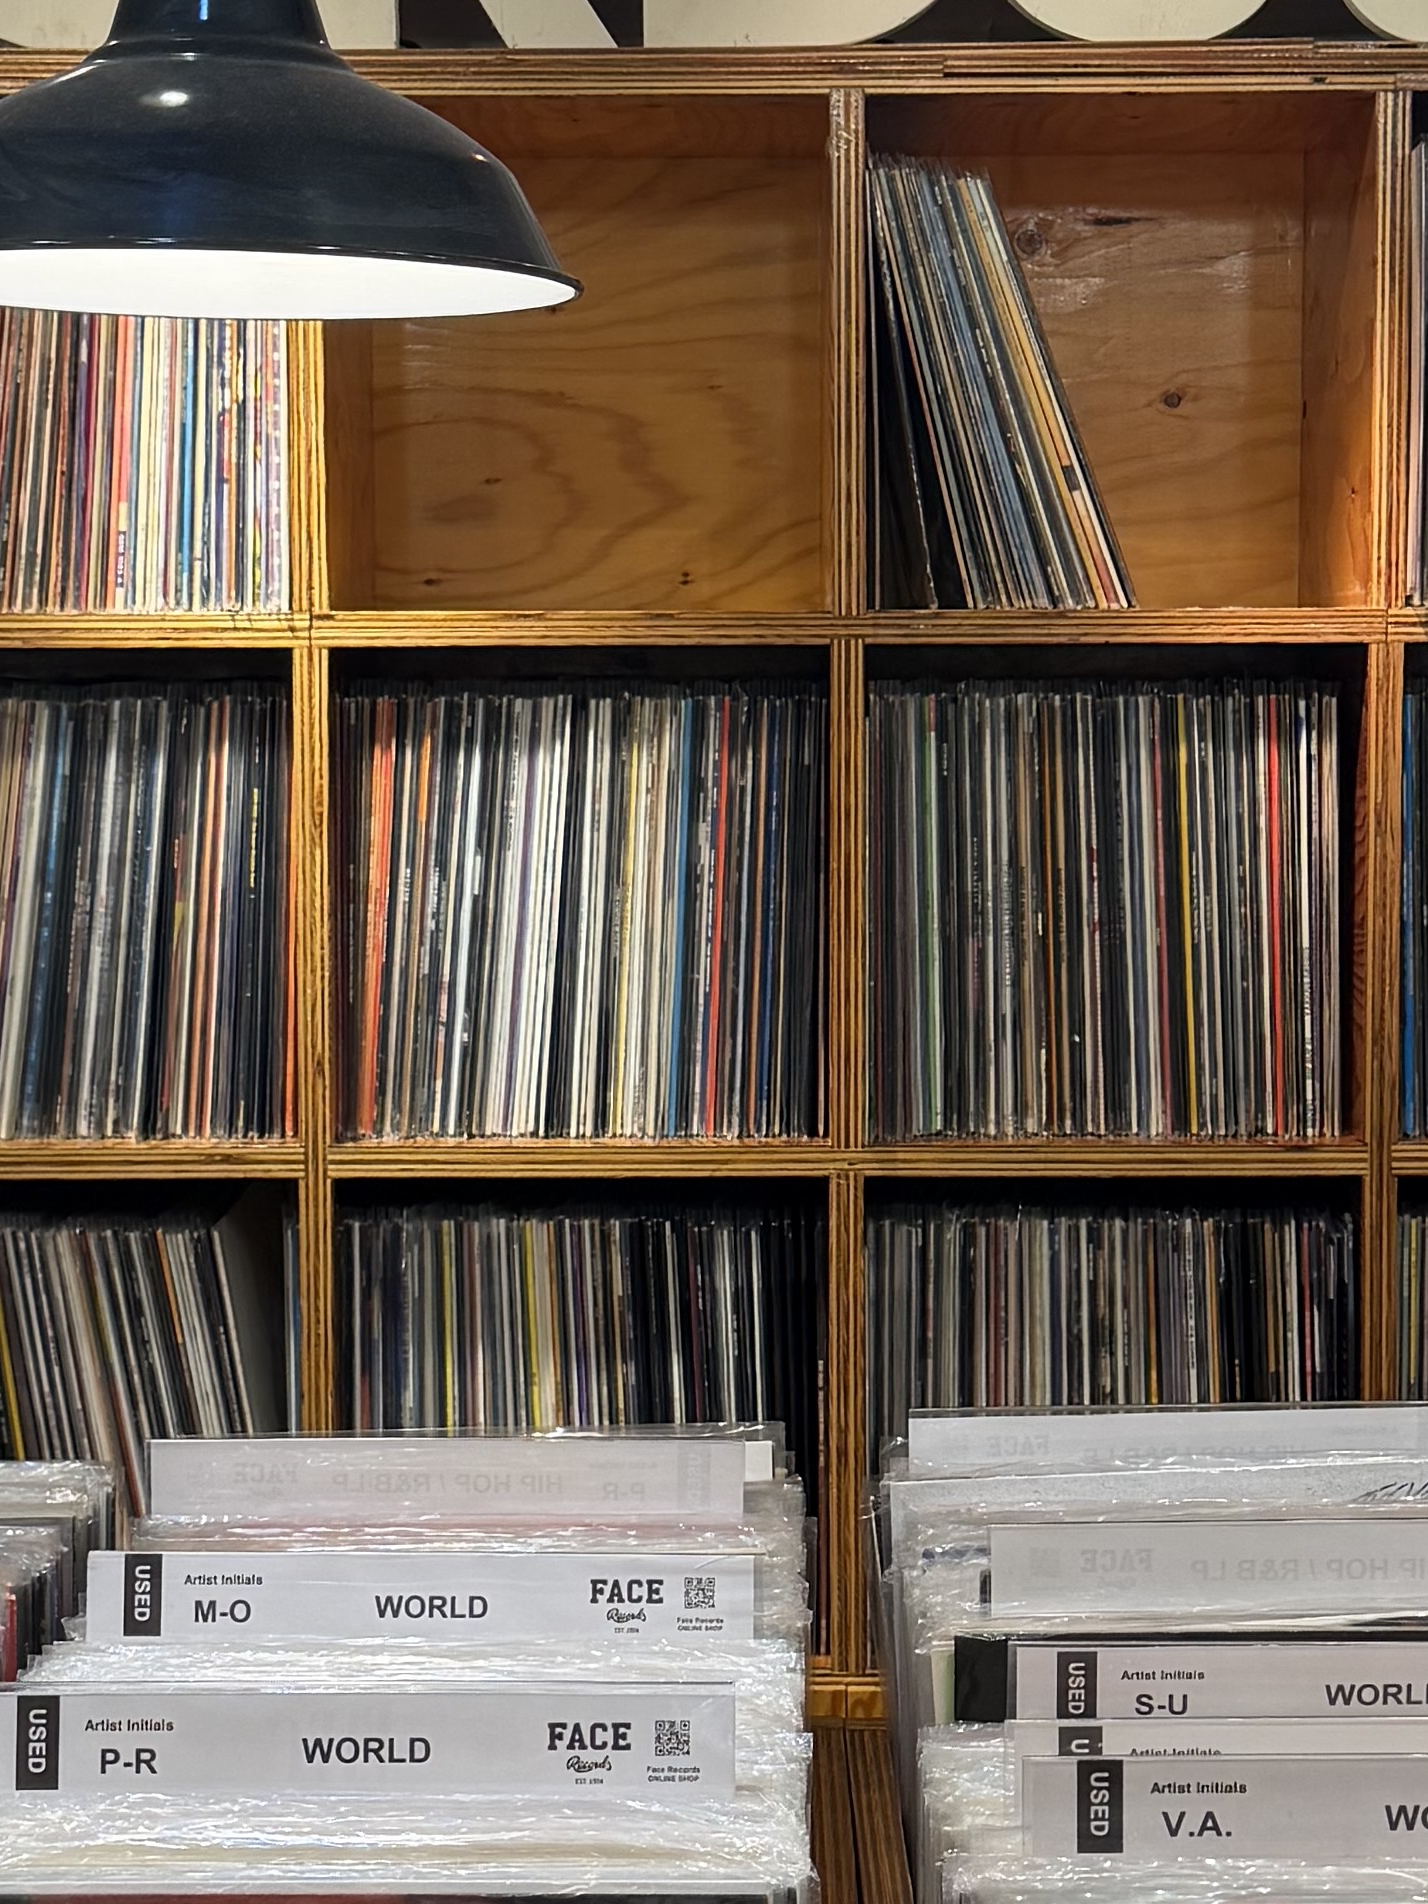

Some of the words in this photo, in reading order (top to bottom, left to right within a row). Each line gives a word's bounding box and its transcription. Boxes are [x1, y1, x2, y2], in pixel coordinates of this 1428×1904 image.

[184, 1574, 218, 1586] Artist
[221, 1573, 264, 1586] Initials
[589, 1578, 665, 1605] FACE
[134, 1565, 151, 1622] USED
[374, 1594, 489, 1620] WORLD
[193, 1599, 252, 1624] M-O
[1121, 1669, 1156, 1680] Artist
[1160, 1669, 1205, 1680] Initials
[1067, 1662, 1086, 1715] USED
[1134, 1693, 1189, 1716] S-U
[84, 1718, 123, 1733] Artist
[126, 1718, 175, 1733] Initials
[546, 1722, 632, 1751] FACE
[27, 1708, 47, 1774] USED
[301, 1736, 432, 1765] WORLD
[99, 1747, 158, 1775] P-R
[1150, 1781, 1192, 1795] Artist
[1196, 1781, 1247, 1795] Initials
[1089, 1772, 1110, 1837] USED
[1162, 1811, 1233, 1838] V.A.
